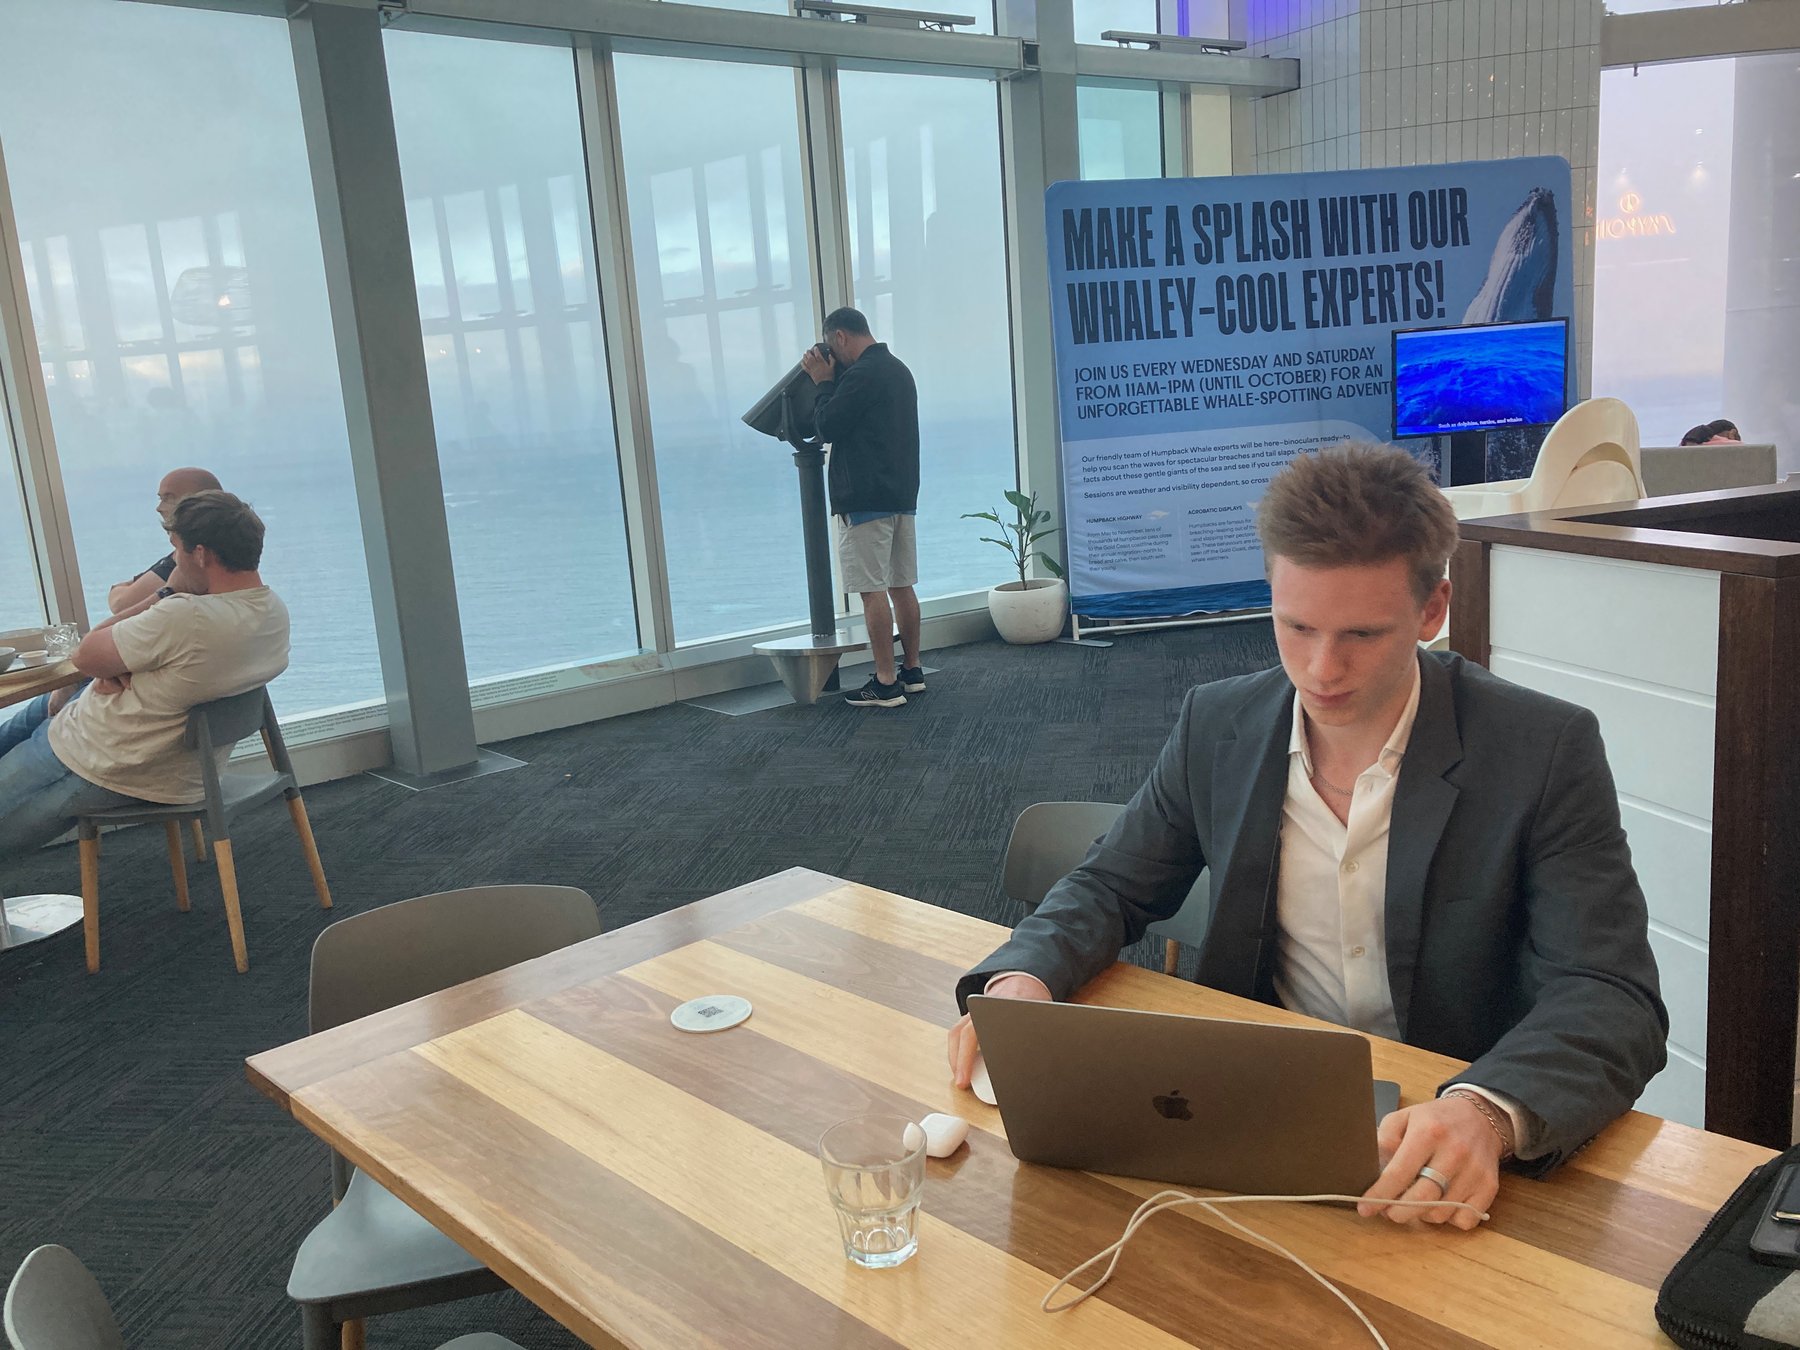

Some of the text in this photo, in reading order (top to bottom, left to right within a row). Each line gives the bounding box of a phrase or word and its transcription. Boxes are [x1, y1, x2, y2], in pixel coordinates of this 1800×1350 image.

[1062, 187, 1470, 271] MAKE A SPLASH WITH OUR
[1067, 260, 1446, 344] WHALEY-COOL EXPERTS!
[1075, 347, 1376, 384] JOIN US EVERY WEDNESDAY AND SATURDAY
[1076, 364, 1383, 401] FROM 11AM-1PM (UNTIL OCTOBER) FOR AN
[1077, 396, 1200, 420] UNFORGETTABLE
[1203, 386, 1332, 409] WHALE-SPOTTING
[1083, 466, 1098, 474] help
[1143, 460, 1165, 468] waves
[1177, 456, 1217, 465] spectacular
[1219, 453, 1250, 461] breaches
[1277, 449, 1296, 457] slaps.
[1298, 447, 1318, 455] Come
[1096, 453, 1122, 461] friendly
[1151, 448, 1188, 457] Humpback
[1190, 445, 1212, 453] Whale
[1213, 442, 1239, 452] experts
[1241, 441, 1252, 449] will
[1144, 470, 1166, 479] gentle
[1167, 468, 1188, 477] giants
[1257, 461, 1270, 469] you
[1084, 491, 1114, 499] Sessions
[1128, 487, 1156, 495] weather
[1172, 482, 1200, 491] visibility
[1201, 476, 1239, 489] dependent,
